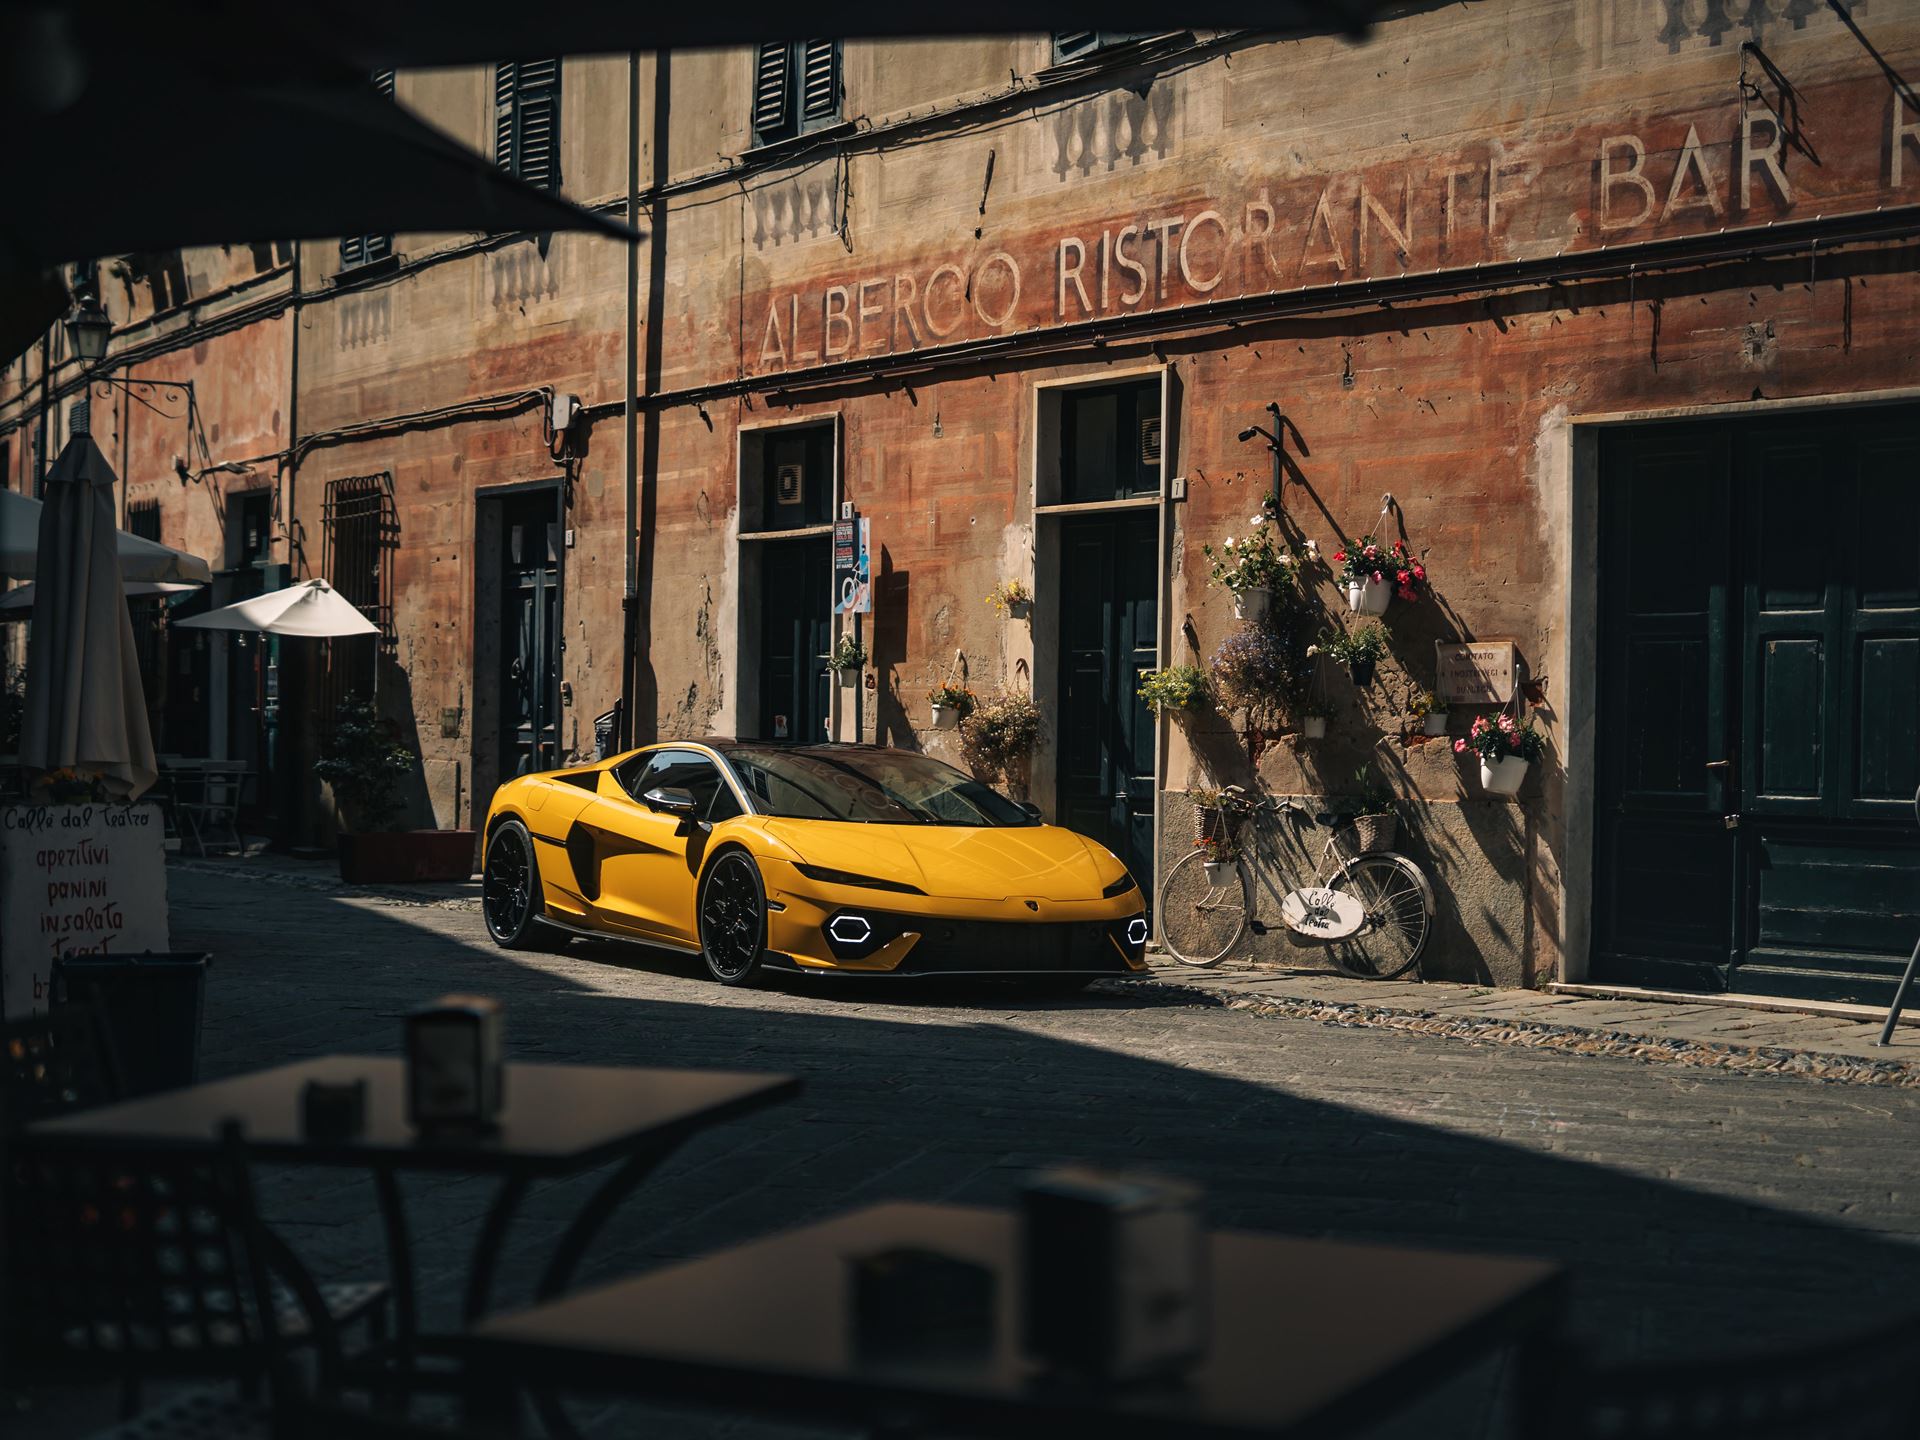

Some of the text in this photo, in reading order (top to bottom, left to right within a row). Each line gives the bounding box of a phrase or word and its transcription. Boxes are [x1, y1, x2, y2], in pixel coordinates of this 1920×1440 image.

[1600, 109, 1796, 230] BAR
[61, 807, 93, 829] dal
[99, 806, 150, 828] Teatro
[36, 838, 110, 875] aperitivi
[47, 876, 107, 907] panini
[40, 902, 123, 933] insalata
